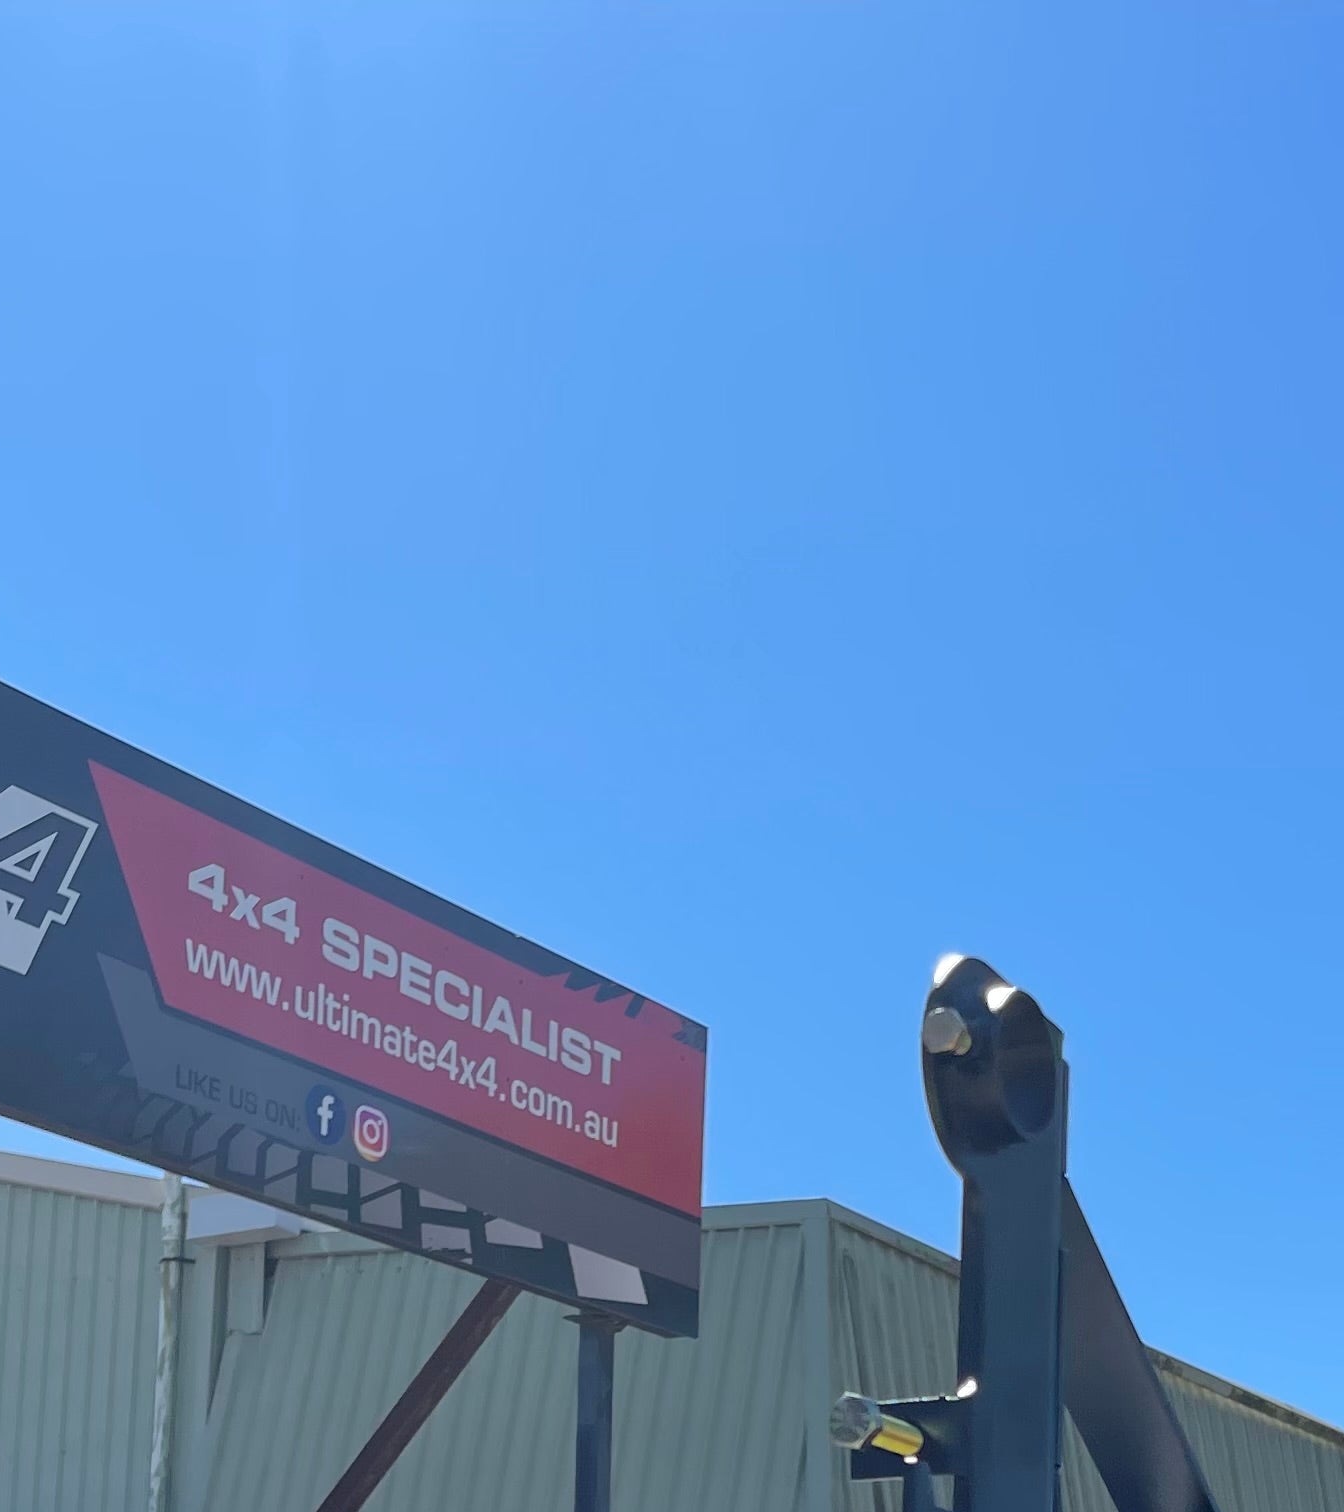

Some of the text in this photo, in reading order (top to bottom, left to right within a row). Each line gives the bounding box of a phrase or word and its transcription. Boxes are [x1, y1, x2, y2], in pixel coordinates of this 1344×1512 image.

[184, 938, 619, 1148] www.ultimate4x4.com.au
[187, 863, 622, 1085] 4x4 SPECIALIST
[175, 1063, 222, 1102] LIKE
[229, 1085, 258, 1115] US
